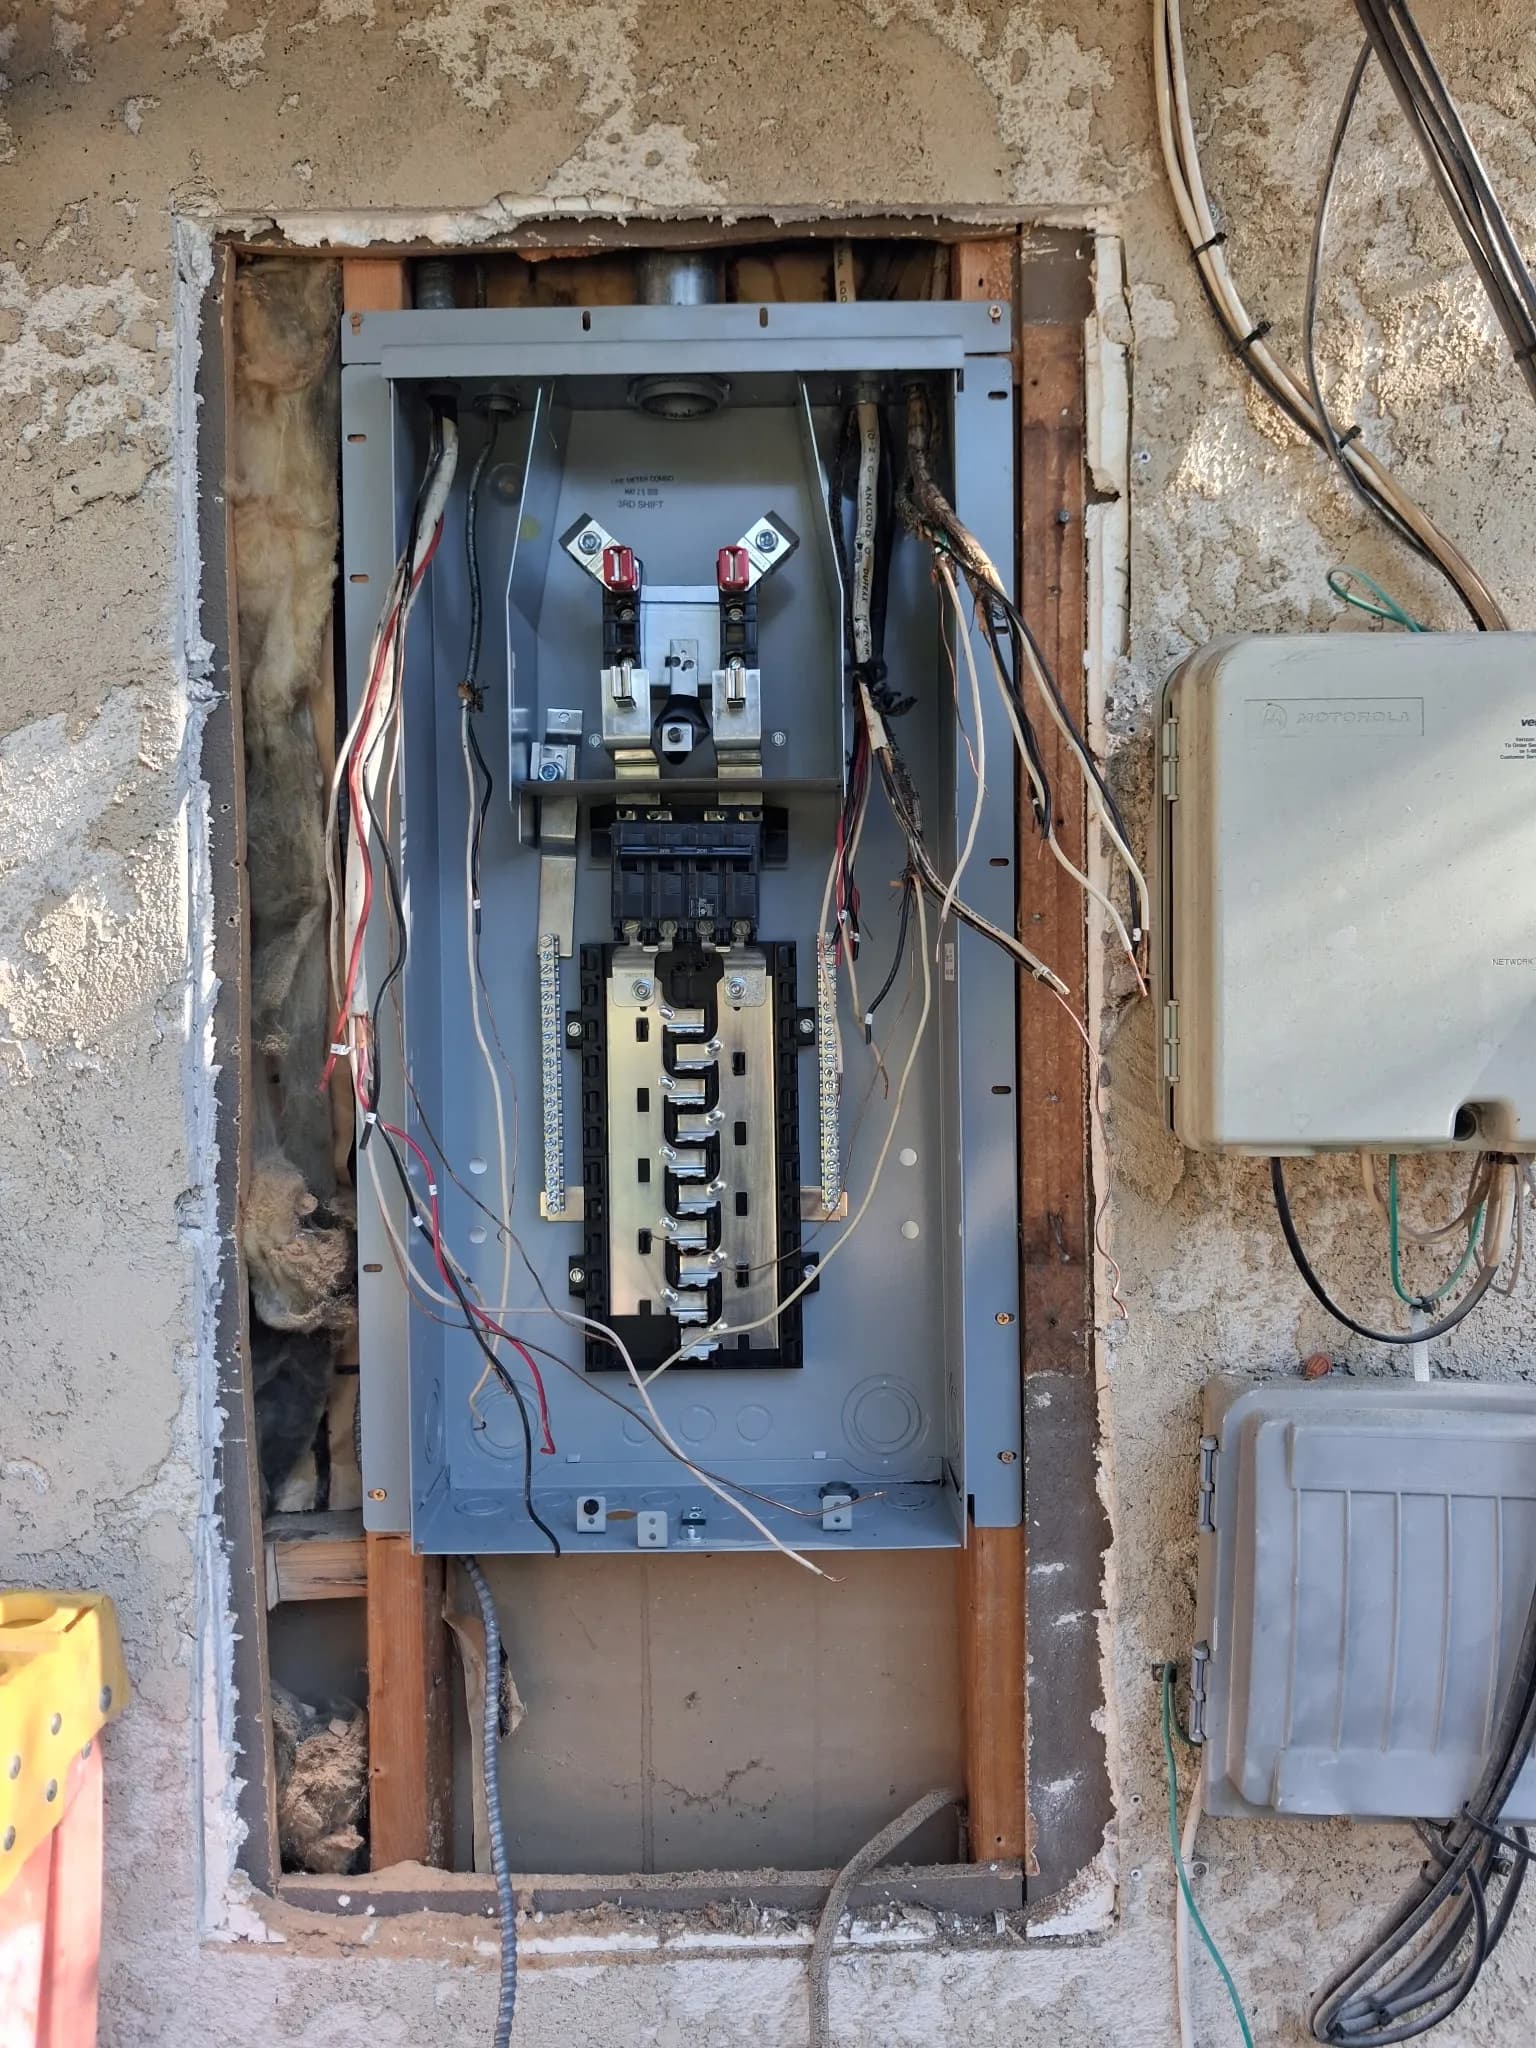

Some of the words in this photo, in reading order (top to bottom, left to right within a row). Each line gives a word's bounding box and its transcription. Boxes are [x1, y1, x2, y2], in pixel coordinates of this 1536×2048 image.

[638, 500, 664, 509] SHIFT
[1296, 711, 1409, 724] MOTOROLA
[1492, 958, 1534, 966] NETWORK
